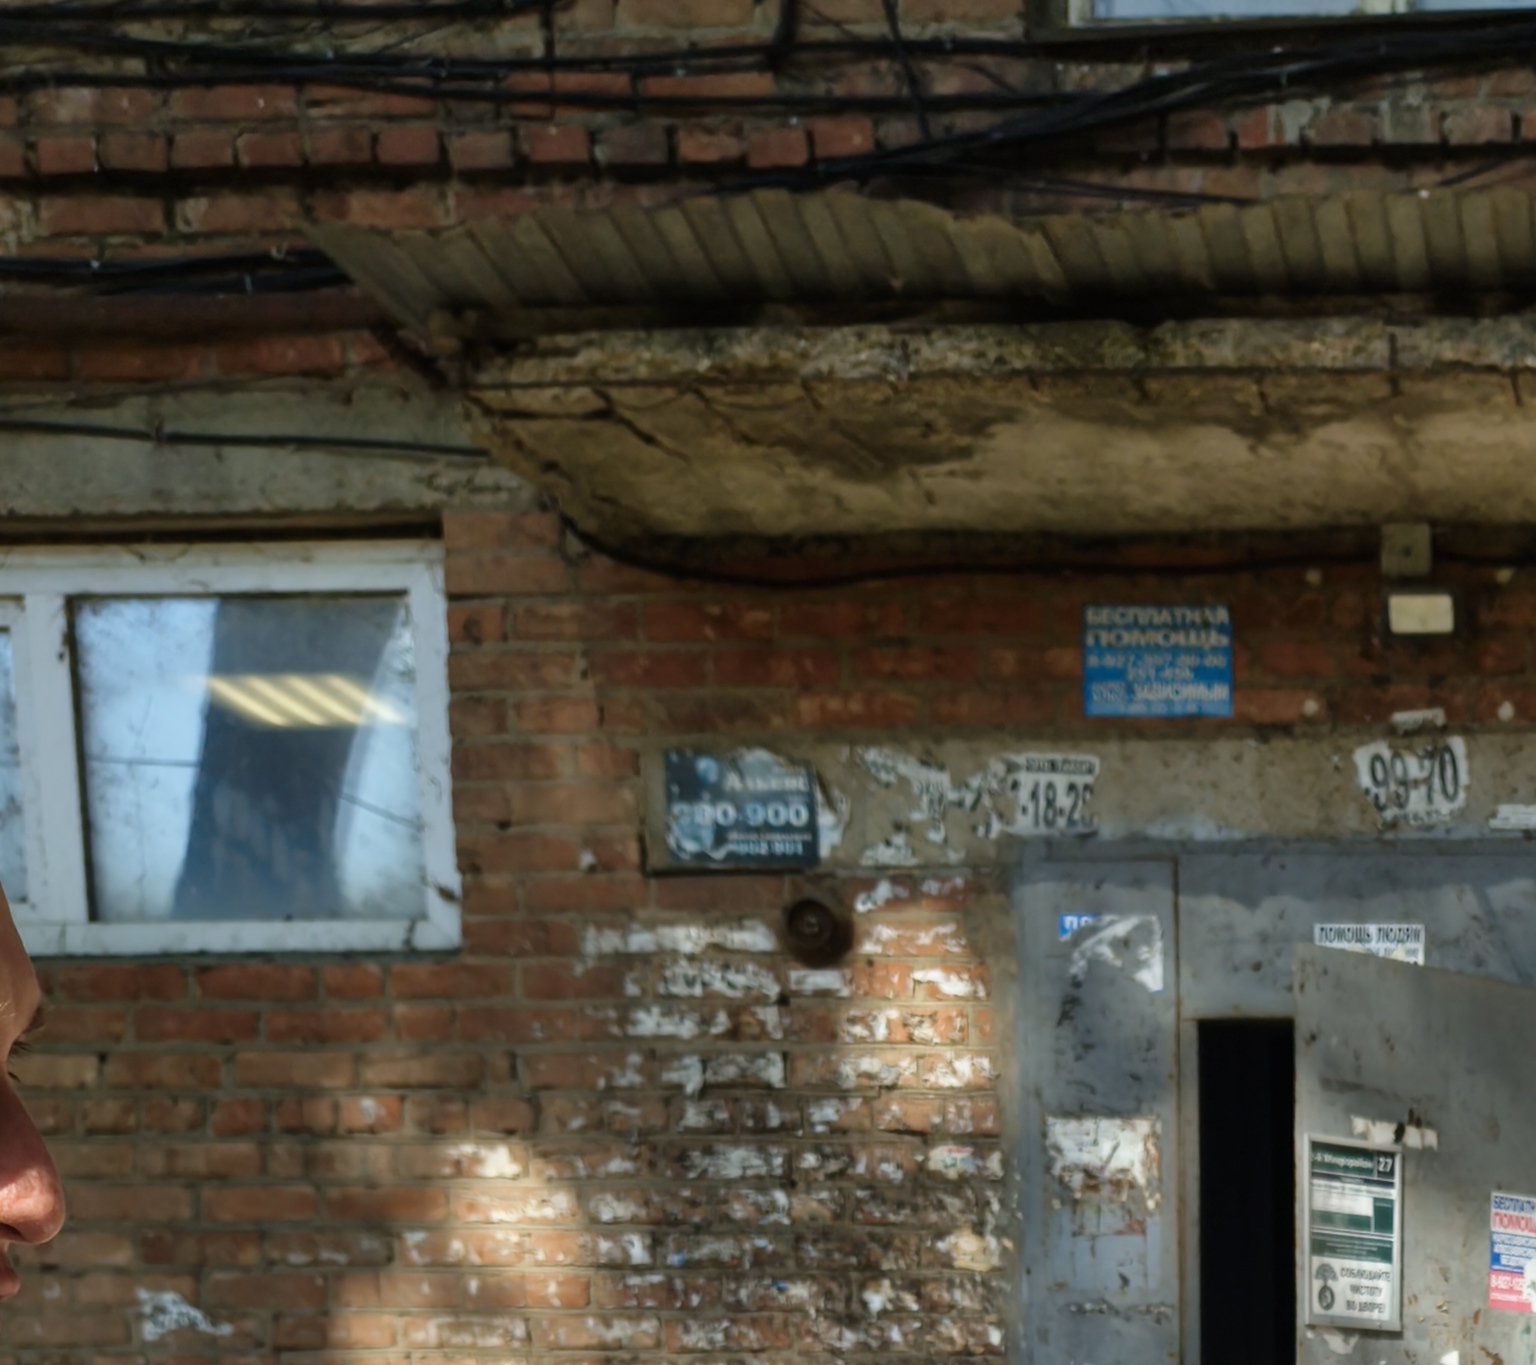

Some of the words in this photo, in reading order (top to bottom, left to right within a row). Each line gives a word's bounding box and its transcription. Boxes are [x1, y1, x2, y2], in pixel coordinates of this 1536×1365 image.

[1085, 628, 1230, 652] ПОМОЩЬ
[1319, 926, 1373, 944] ПОМОЩЬ
[1378, 1157, 1394, 1173] 27
[1340, 1266, 1392, 1282] СОБЛЮДАЙТЕ
[1349, 1283, 1383, 1298] ЧИСТОТУ
